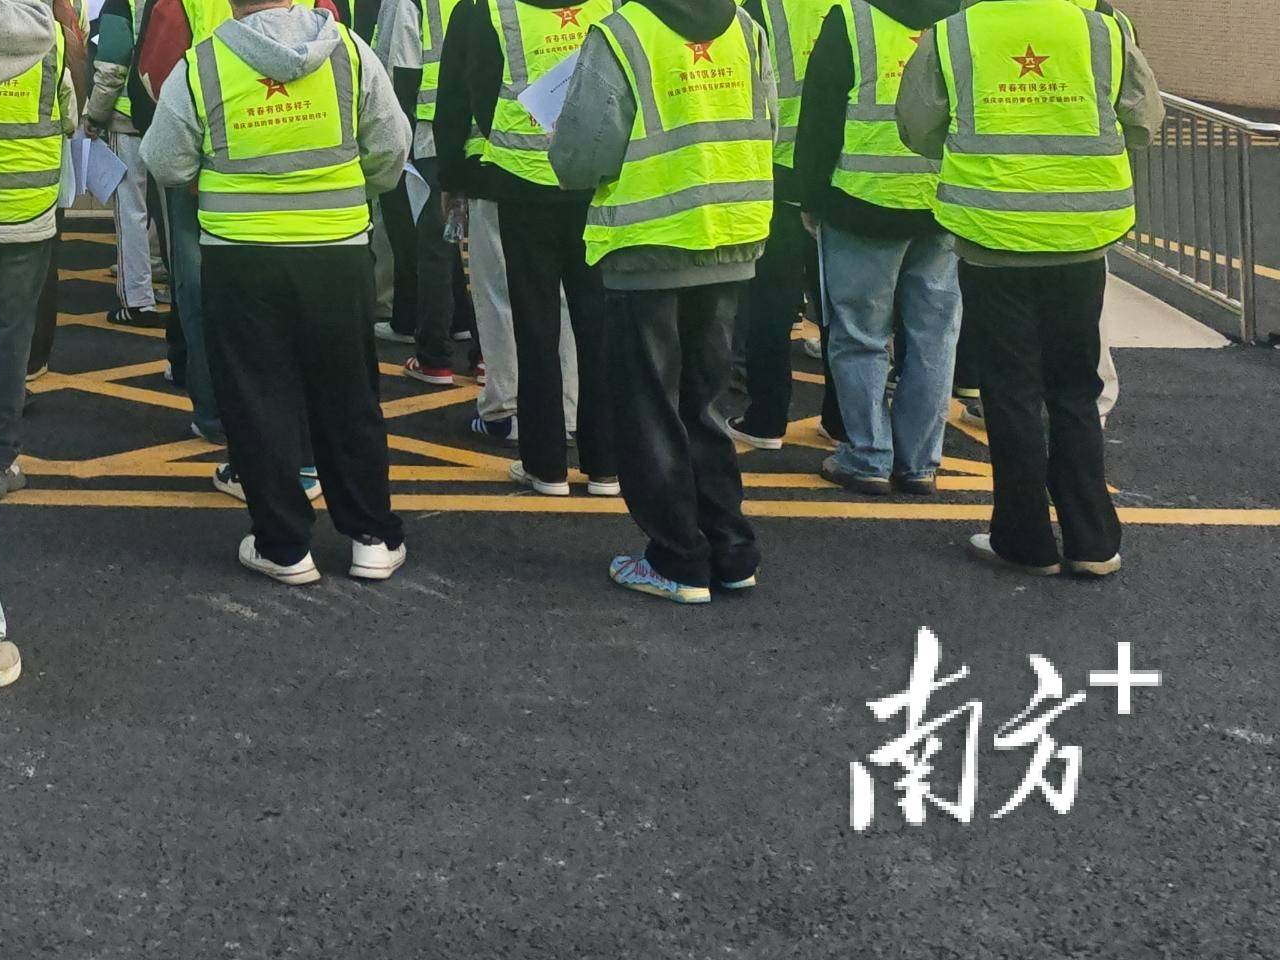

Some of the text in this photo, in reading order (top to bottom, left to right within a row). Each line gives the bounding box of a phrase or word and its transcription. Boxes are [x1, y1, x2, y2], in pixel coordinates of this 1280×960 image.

[998, 83, 1069, 92] 青春有很多样子
[246, 100, 312, 117] 青春有很多样子
